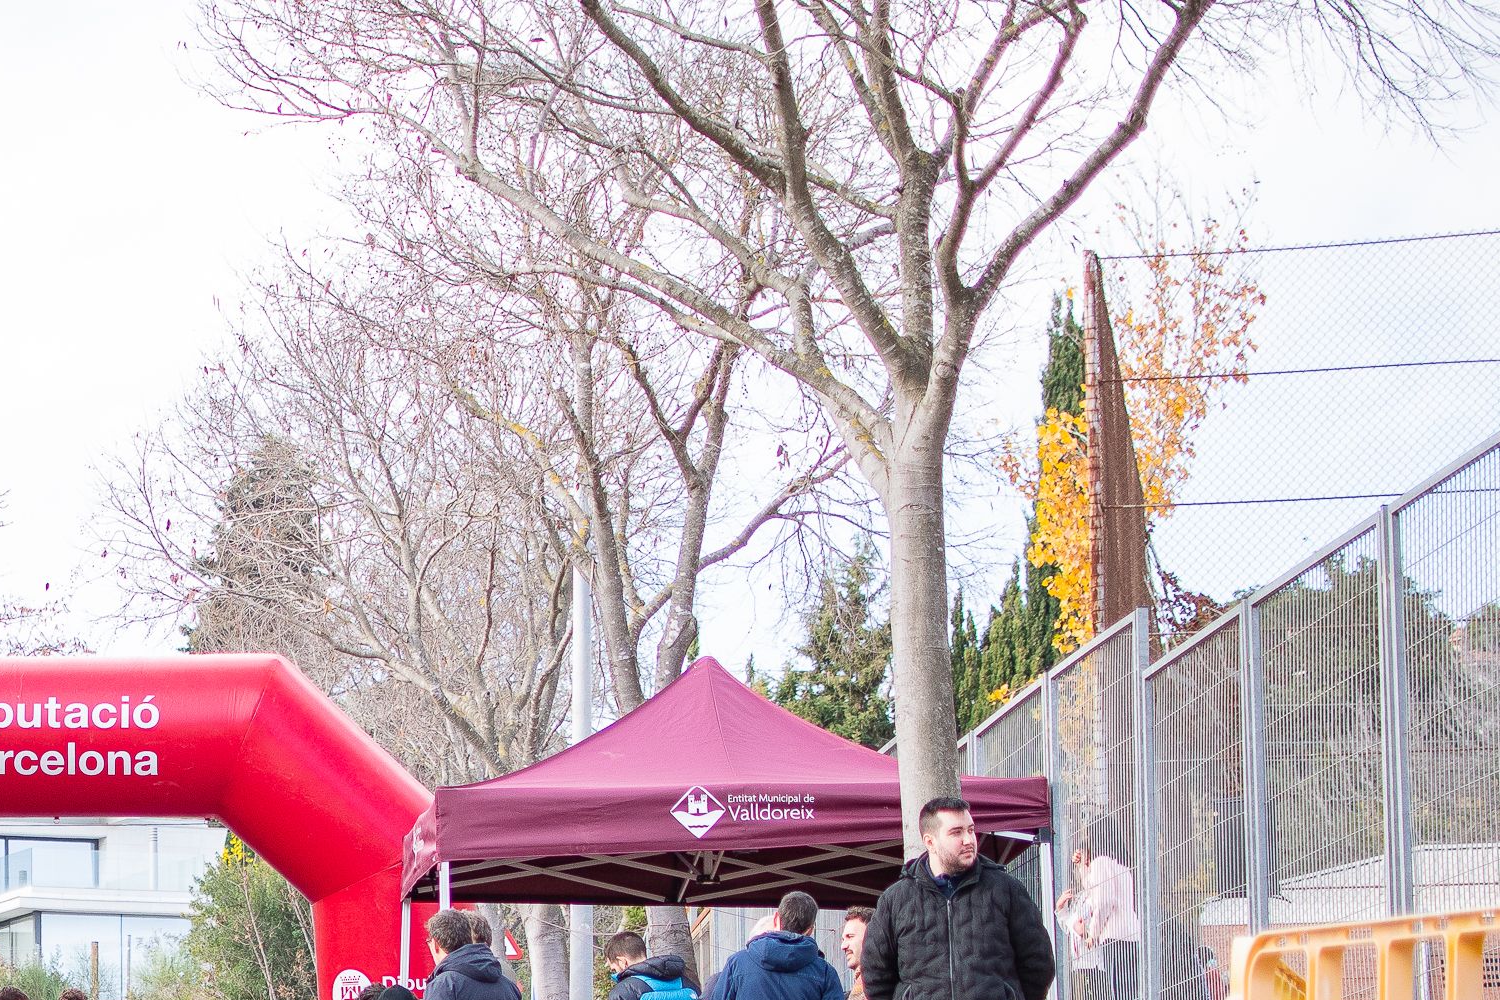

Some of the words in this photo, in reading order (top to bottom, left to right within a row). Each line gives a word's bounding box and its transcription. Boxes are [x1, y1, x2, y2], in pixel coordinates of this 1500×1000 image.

[727, 794, 757, 803] Entitat
[758, 794, 801, 805] Municipal
[803, 794, 815, 803] de
[727, 804, 815, 822] Valldoreix
